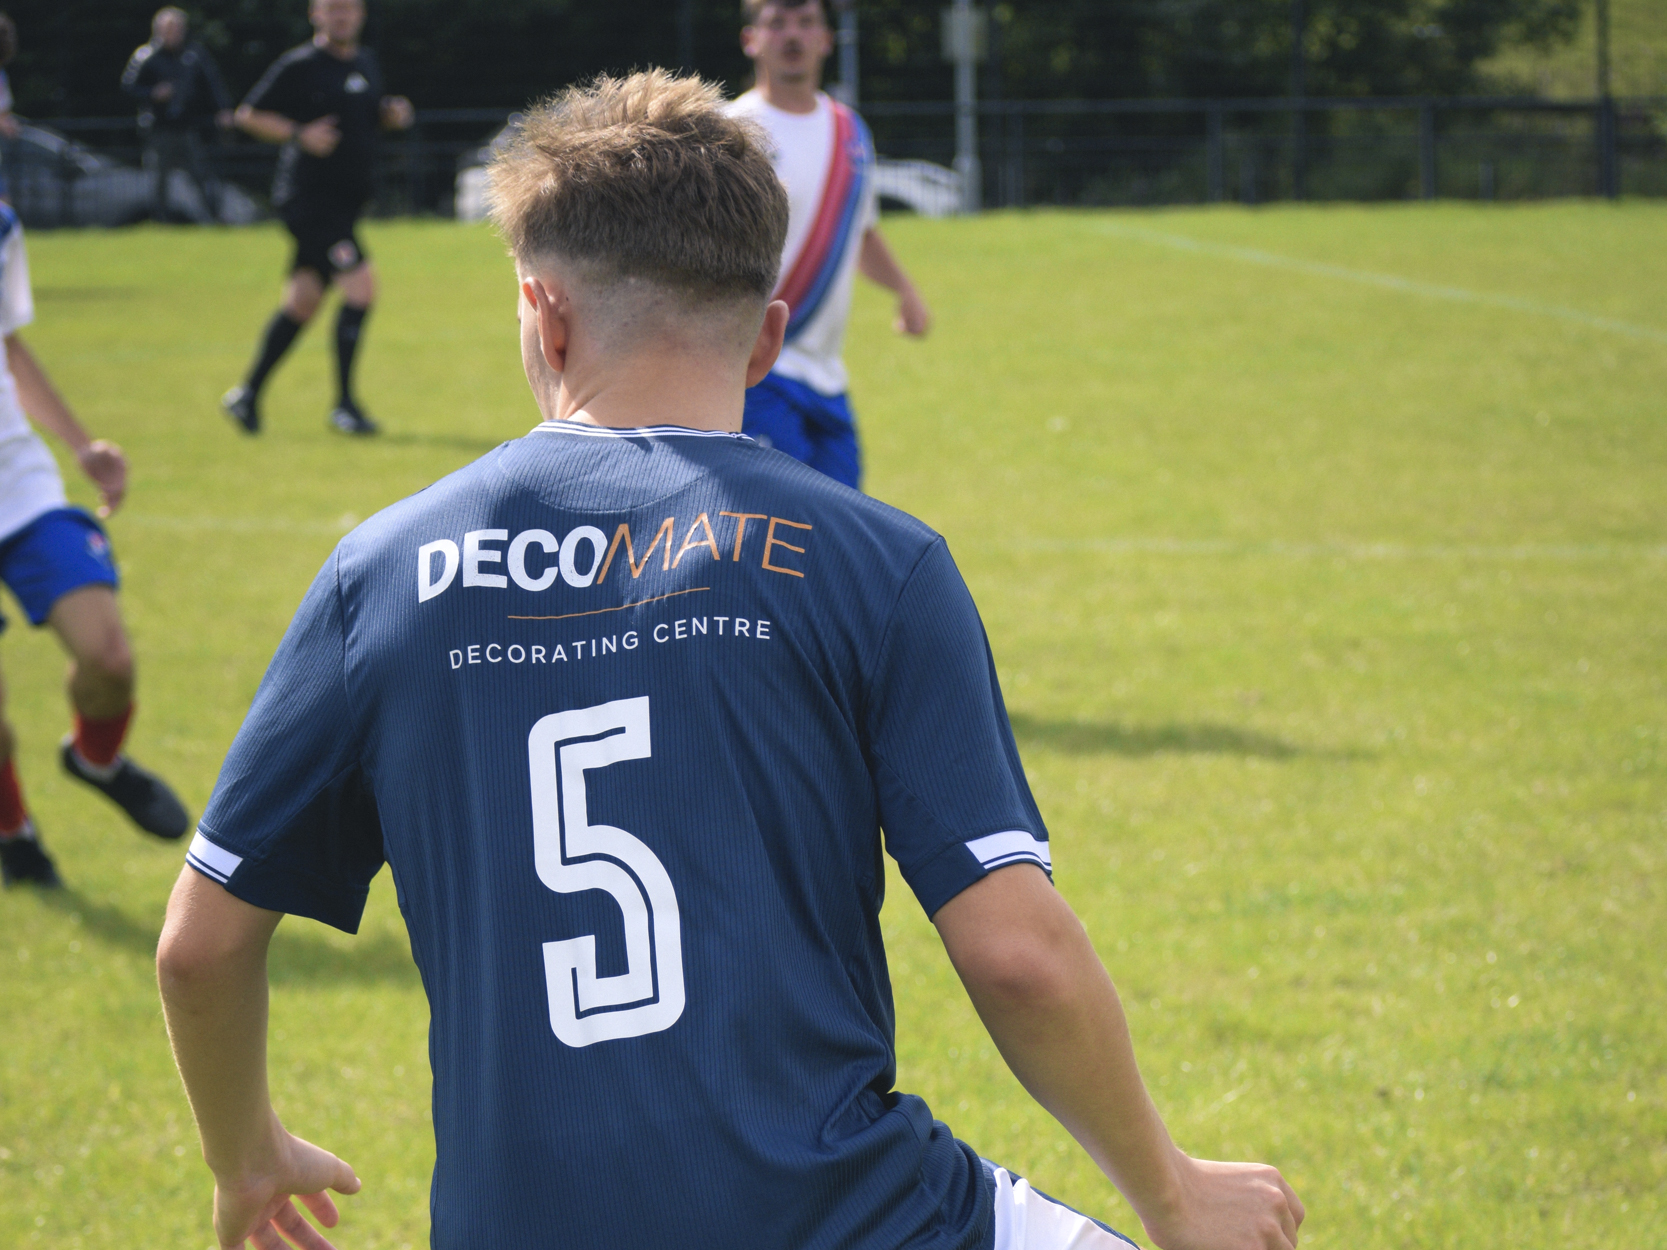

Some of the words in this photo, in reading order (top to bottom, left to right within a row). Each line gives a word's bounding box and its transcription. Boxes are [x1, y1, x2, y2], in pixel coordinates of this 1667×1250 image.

[418, 512, 812, 603] DECOMATE
[449, 632, 640, 669] DECORATING
[653, 617, 771, 643] CENTRE
[528, 695, 686, 1048] 5
